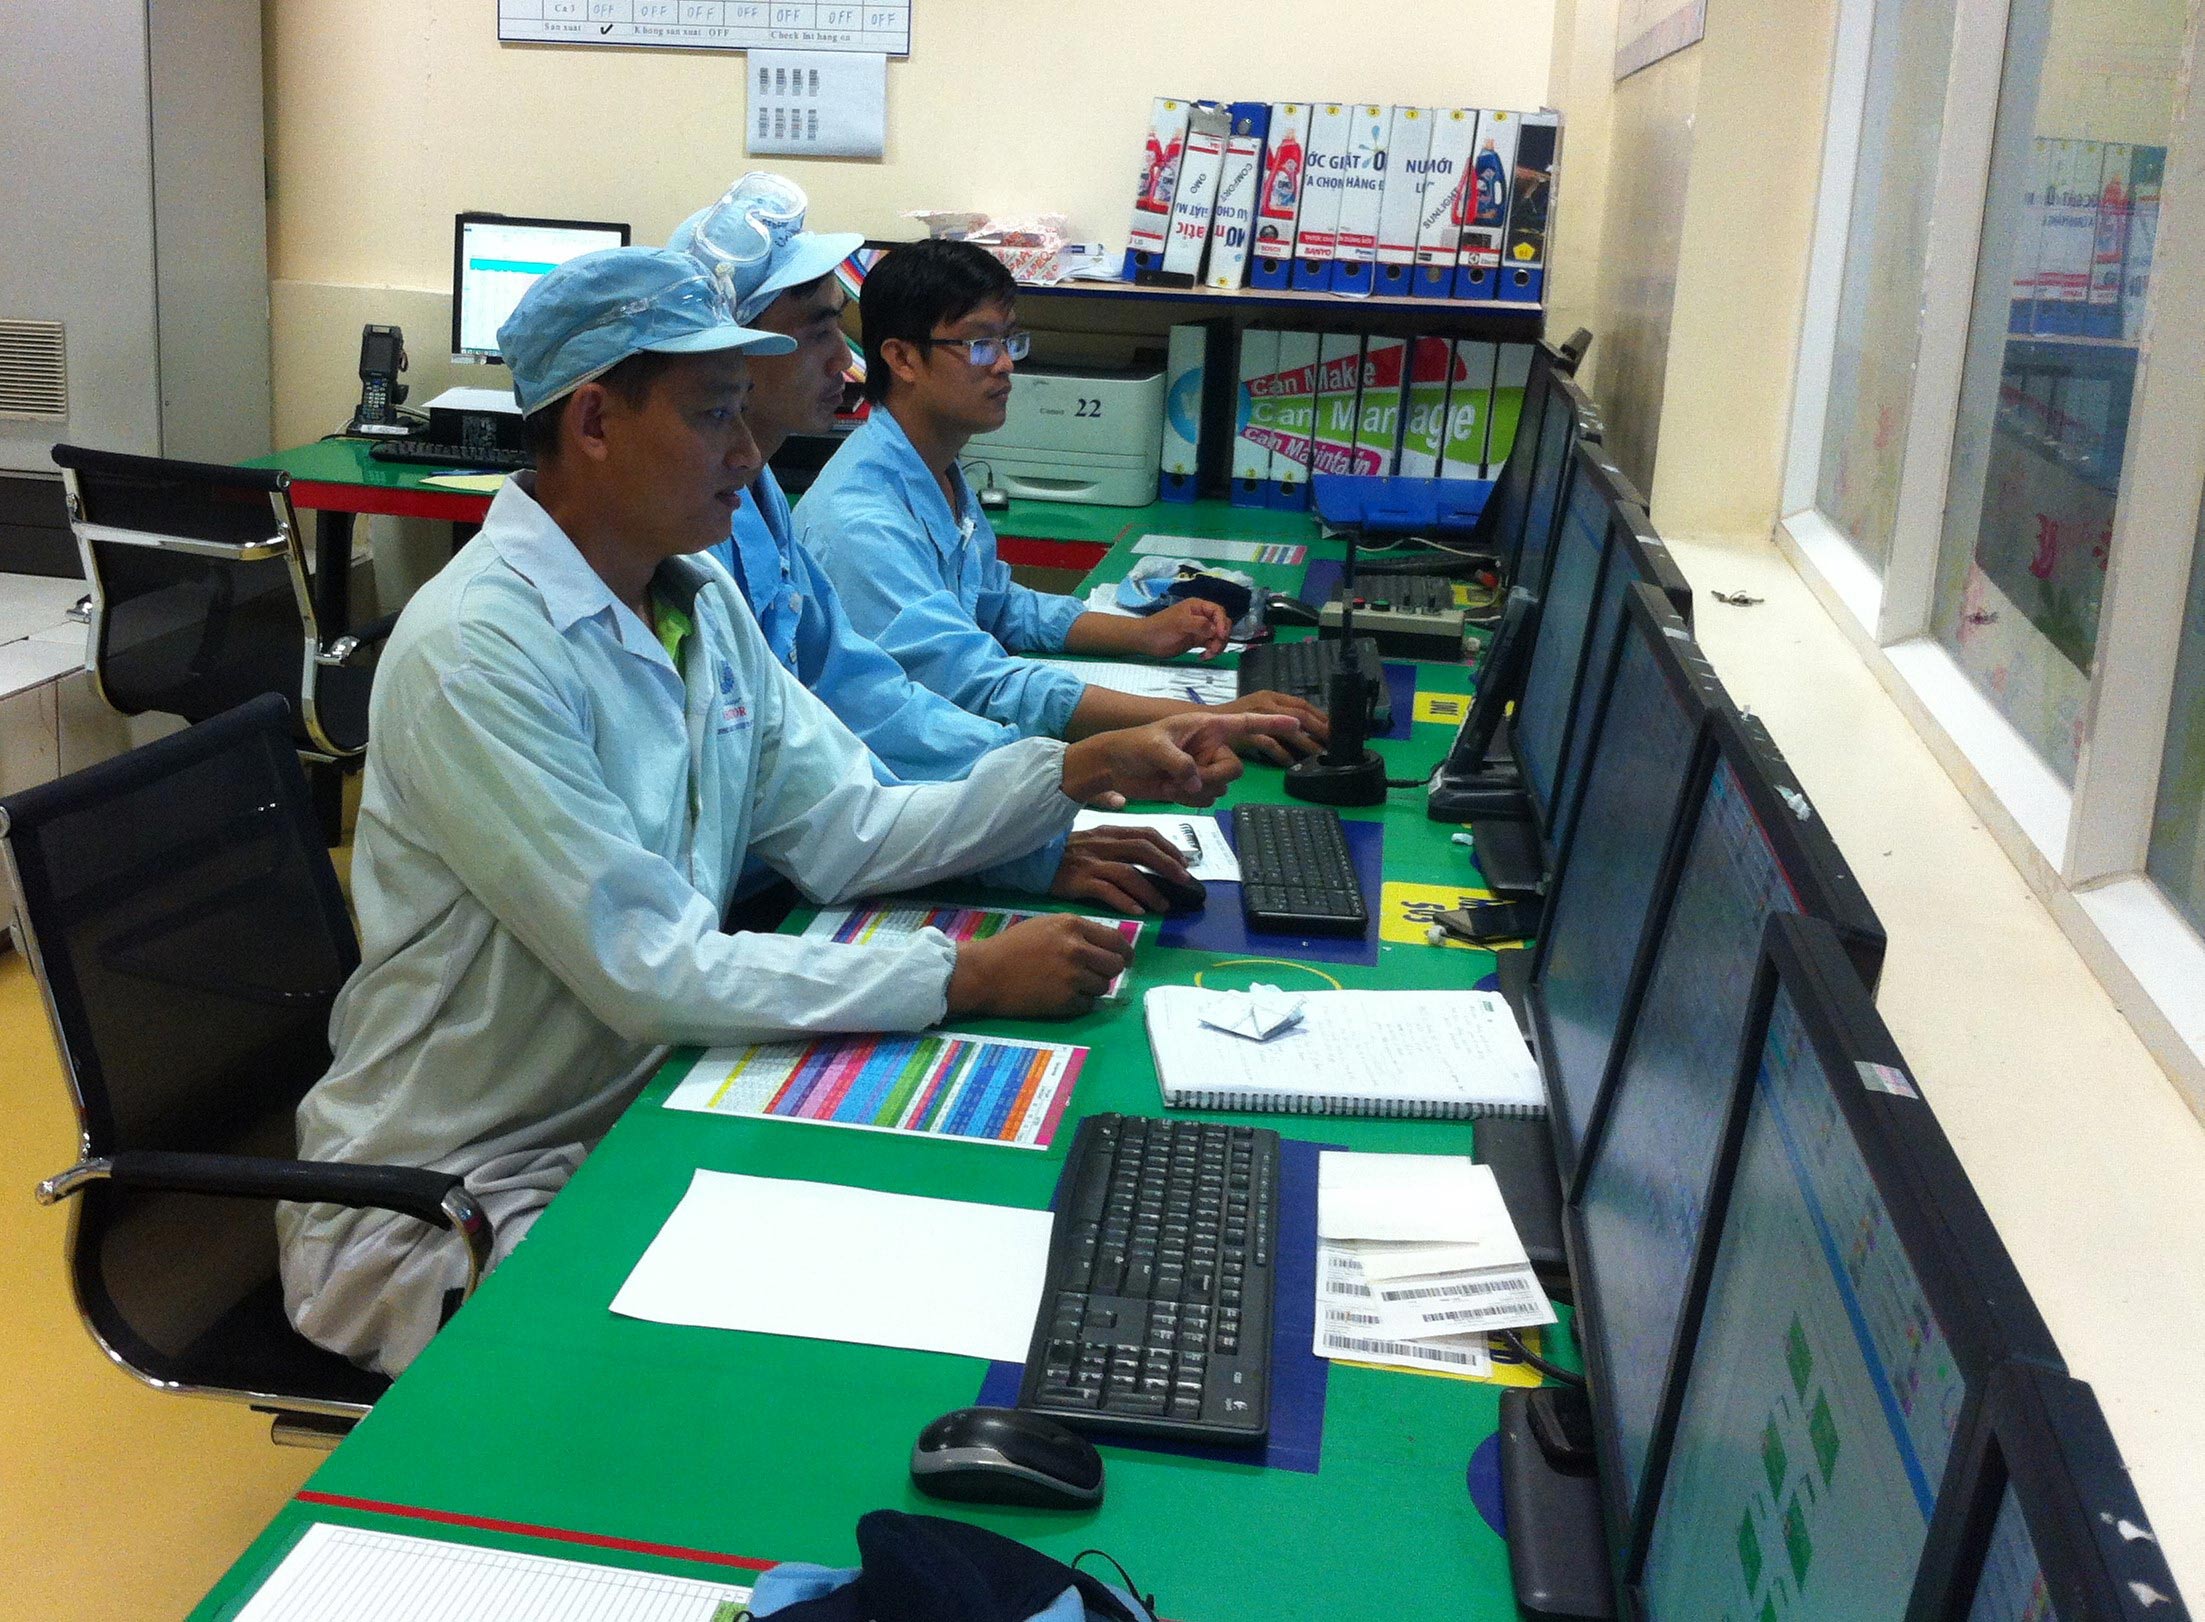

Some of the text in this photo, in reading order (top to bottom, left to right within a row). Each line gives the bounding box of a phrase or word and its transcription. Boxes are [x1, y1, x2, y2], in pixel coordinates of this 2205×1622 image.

[641, 6, 668, 17] OFF
[687, 6, 715, 20] OFF
[737, 7, 758, 18] OFF
[776, 9, 801, 22] OFF
[829, 10, 853, 25] OFF
[871, 13, 896, 25] OFF
[708, 28, 731, 37] OFF
[770, 30, 799, 40] Check
[1190, 173, 1207, 194] OMO
[1220, 163, 1253, 202] COMFORT
[1422, 186, 1461, 230] SUNLIGHT
[1304, 247, 1333, 257] SANYO
[1251, 358, 1377, 396] Can Make
[1074, 398, 1102, 418] 22
[1253, 400, 1476, 449] Can Manage
[1244, 428, 1372, 475] Can Maintain
